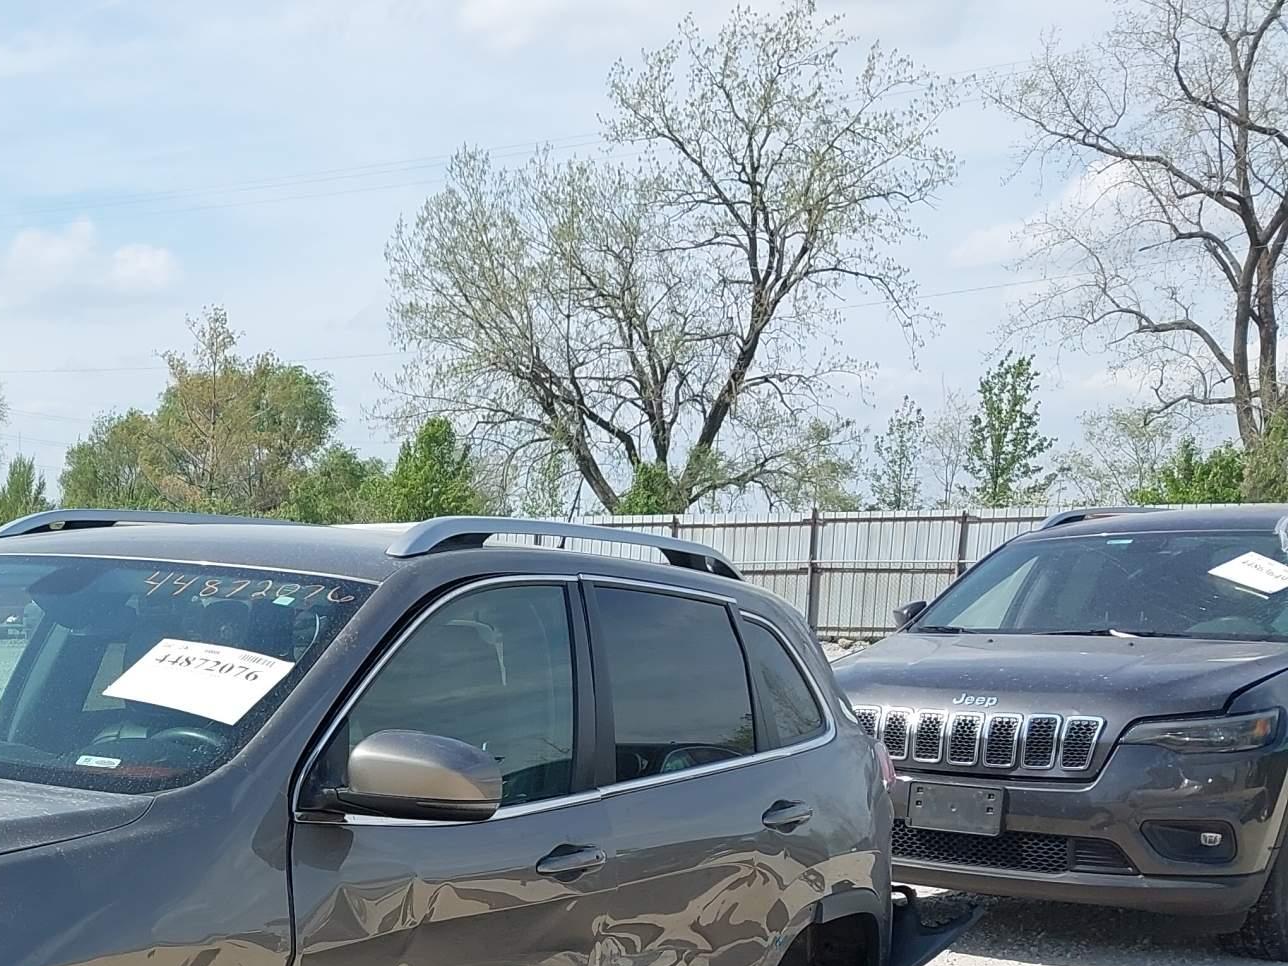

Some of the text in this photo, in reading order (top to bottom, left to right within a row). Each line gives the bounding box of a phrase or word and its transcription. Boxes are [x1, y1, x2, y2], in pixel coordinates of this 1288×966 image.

[143, 571, 356, 603] 44872076
[155, 653, 263, 682] 44872076
[952, 692, 998, 708] Jeep
